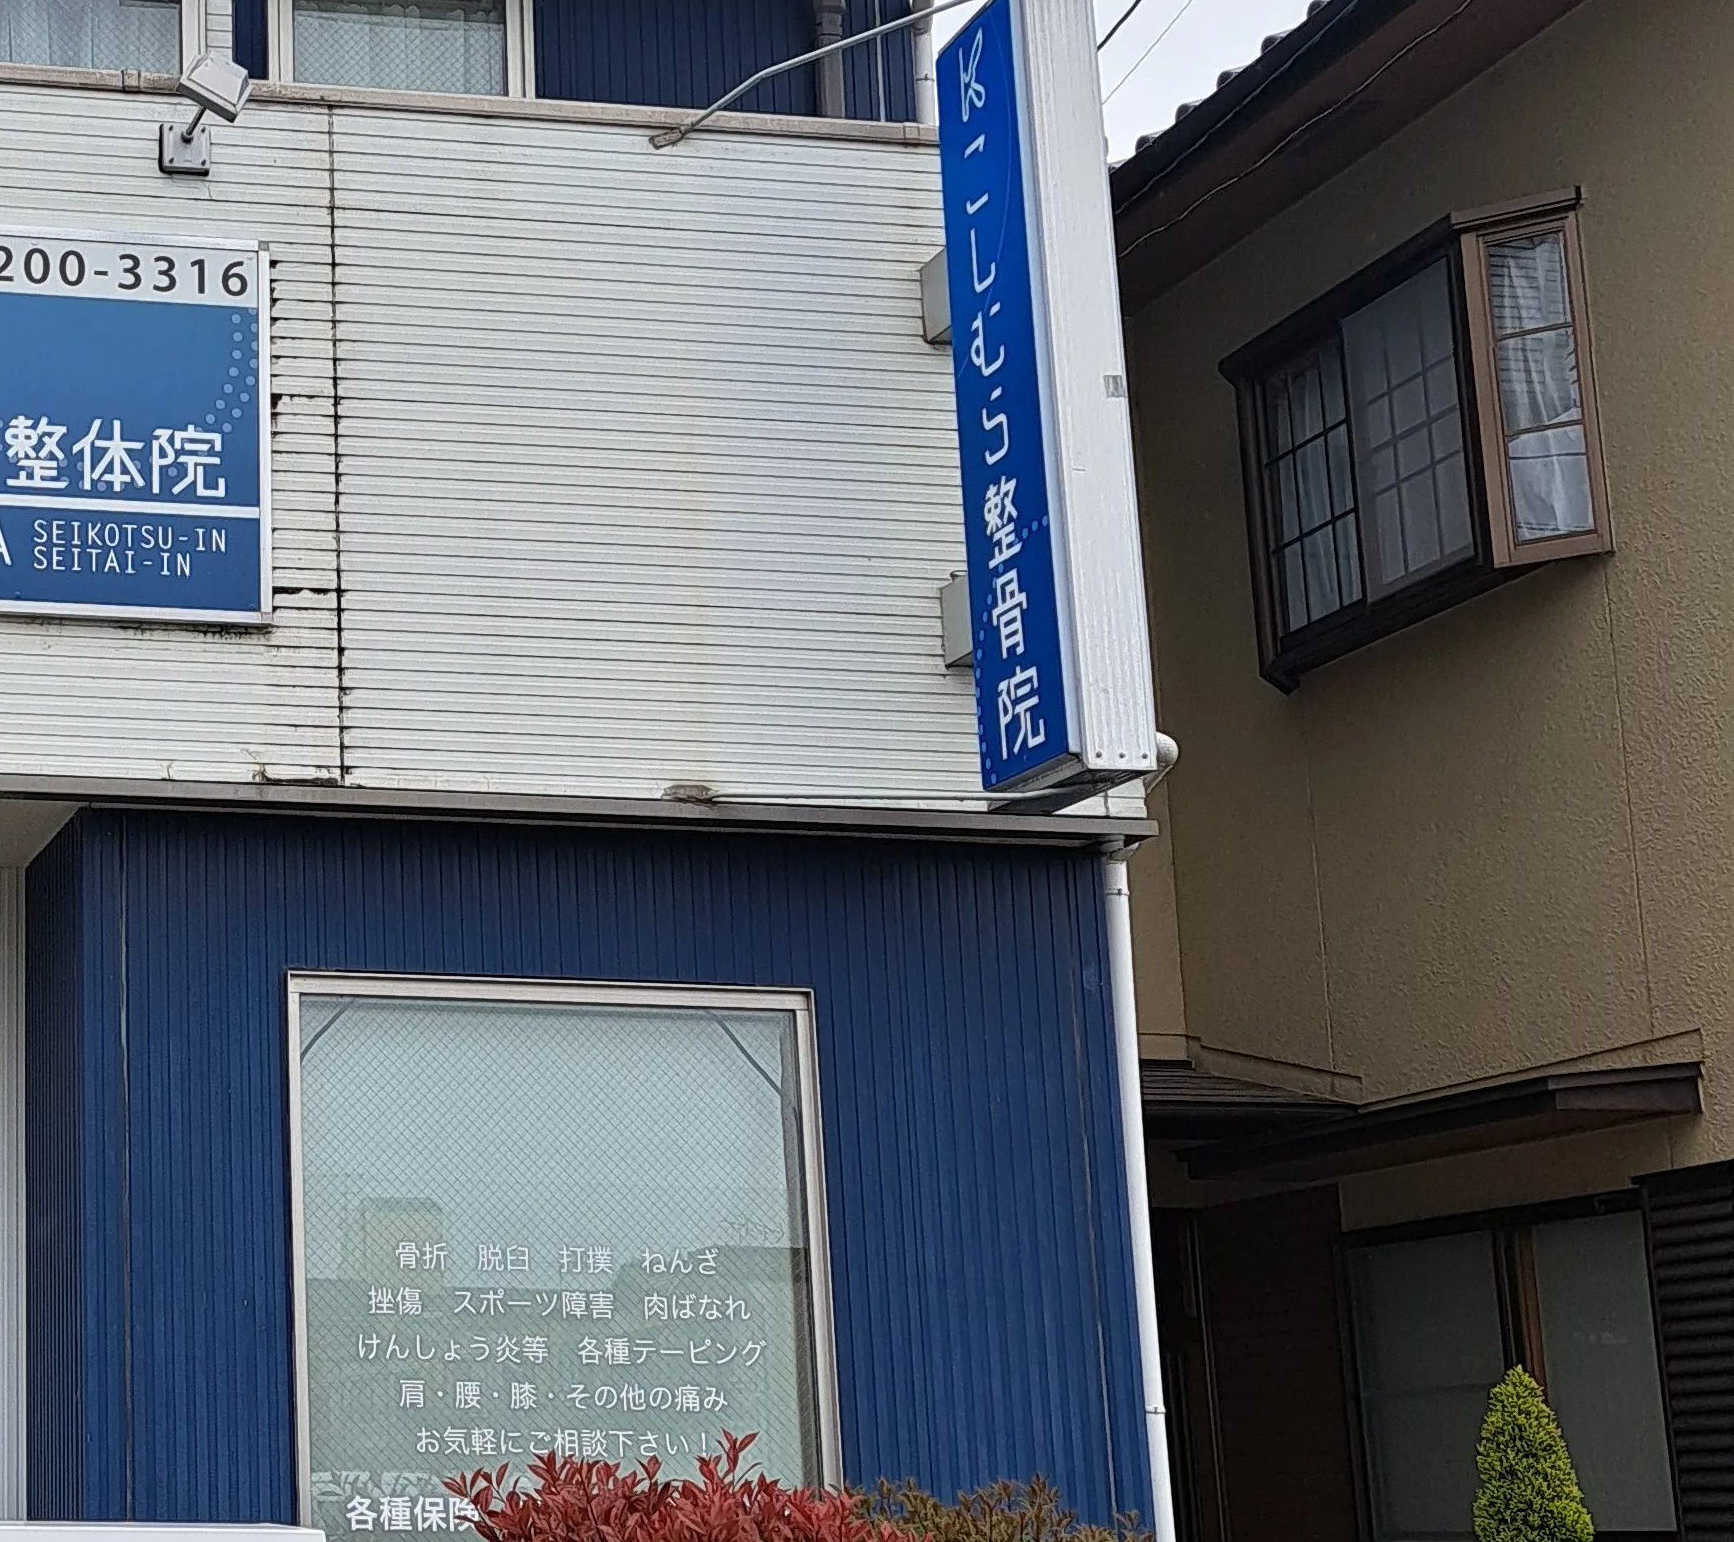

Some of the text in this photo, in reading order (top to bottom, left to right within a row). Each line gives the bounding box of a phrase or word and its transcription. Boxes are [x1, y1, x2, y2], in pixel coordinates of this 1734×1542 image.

[963, 141, 1044, 761] こしむら整骨院
[33, 519, 227, 555] SEIKOTSU-IN
[33, 546, 193, 578] SEITAI-IN
[395, 1241, 720, 1275] 骨折 脱臼 打撲 ねんざ
[367, 1286, 751, 1321] 挫傷 スポーツ障害 肉ばなれ
[357, 1333, 767, 1368] けんしょう炎等 各種テーピング
[399, 1380, 728, 1413] 肩・腰・膝・その他の痛み
